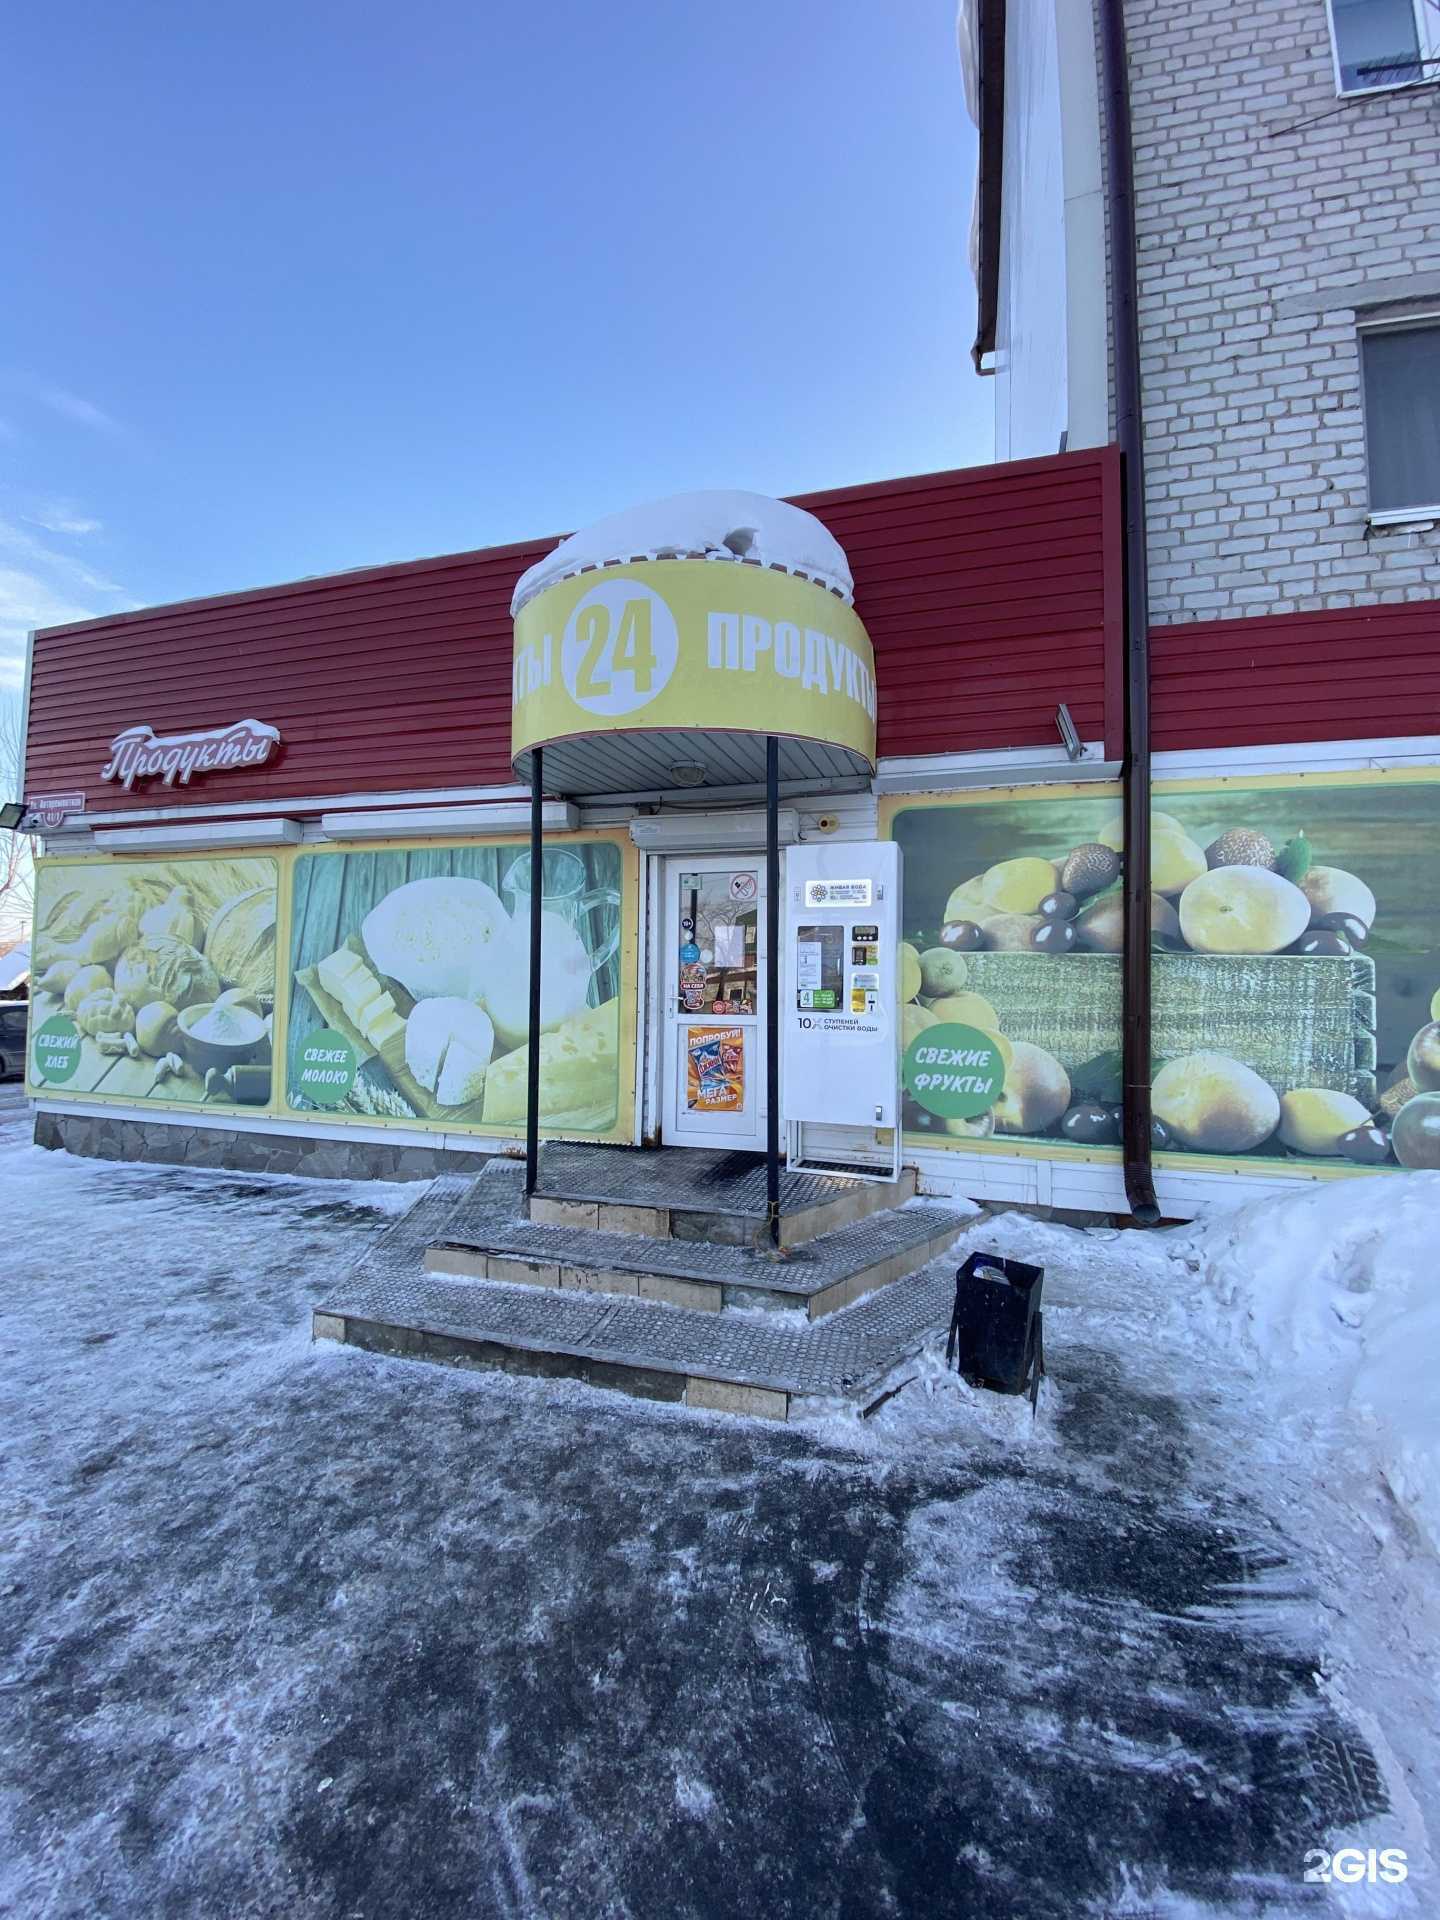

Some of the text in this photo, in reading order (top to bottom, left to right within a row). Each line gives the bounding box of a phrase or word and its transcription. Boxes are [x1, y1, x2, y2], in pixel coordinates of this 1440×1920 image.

[575, 598, 657, 698] 24
[101, 730, 269, 790] Продукты
[37, 1032, 79, 1048] СВЕЖИЙ
[689, 1029, 741, 1046] ПОПРОБУЙ!
[44, 1056, 69, 1069] ХЛЕБ
[303, 1048, 348, 1064] СВЕЖЕЕ
[915, 1047, 991, 1067] СВЕЖИЕ
[301, 1069, 349, 1085] МОЛОКО
[914, 1073, 993, 1094] ФРУКТЫ
[697, 1085, 728, 1100] МЕГА
[705, 1094, 737, 1105] РАЗМЕР
